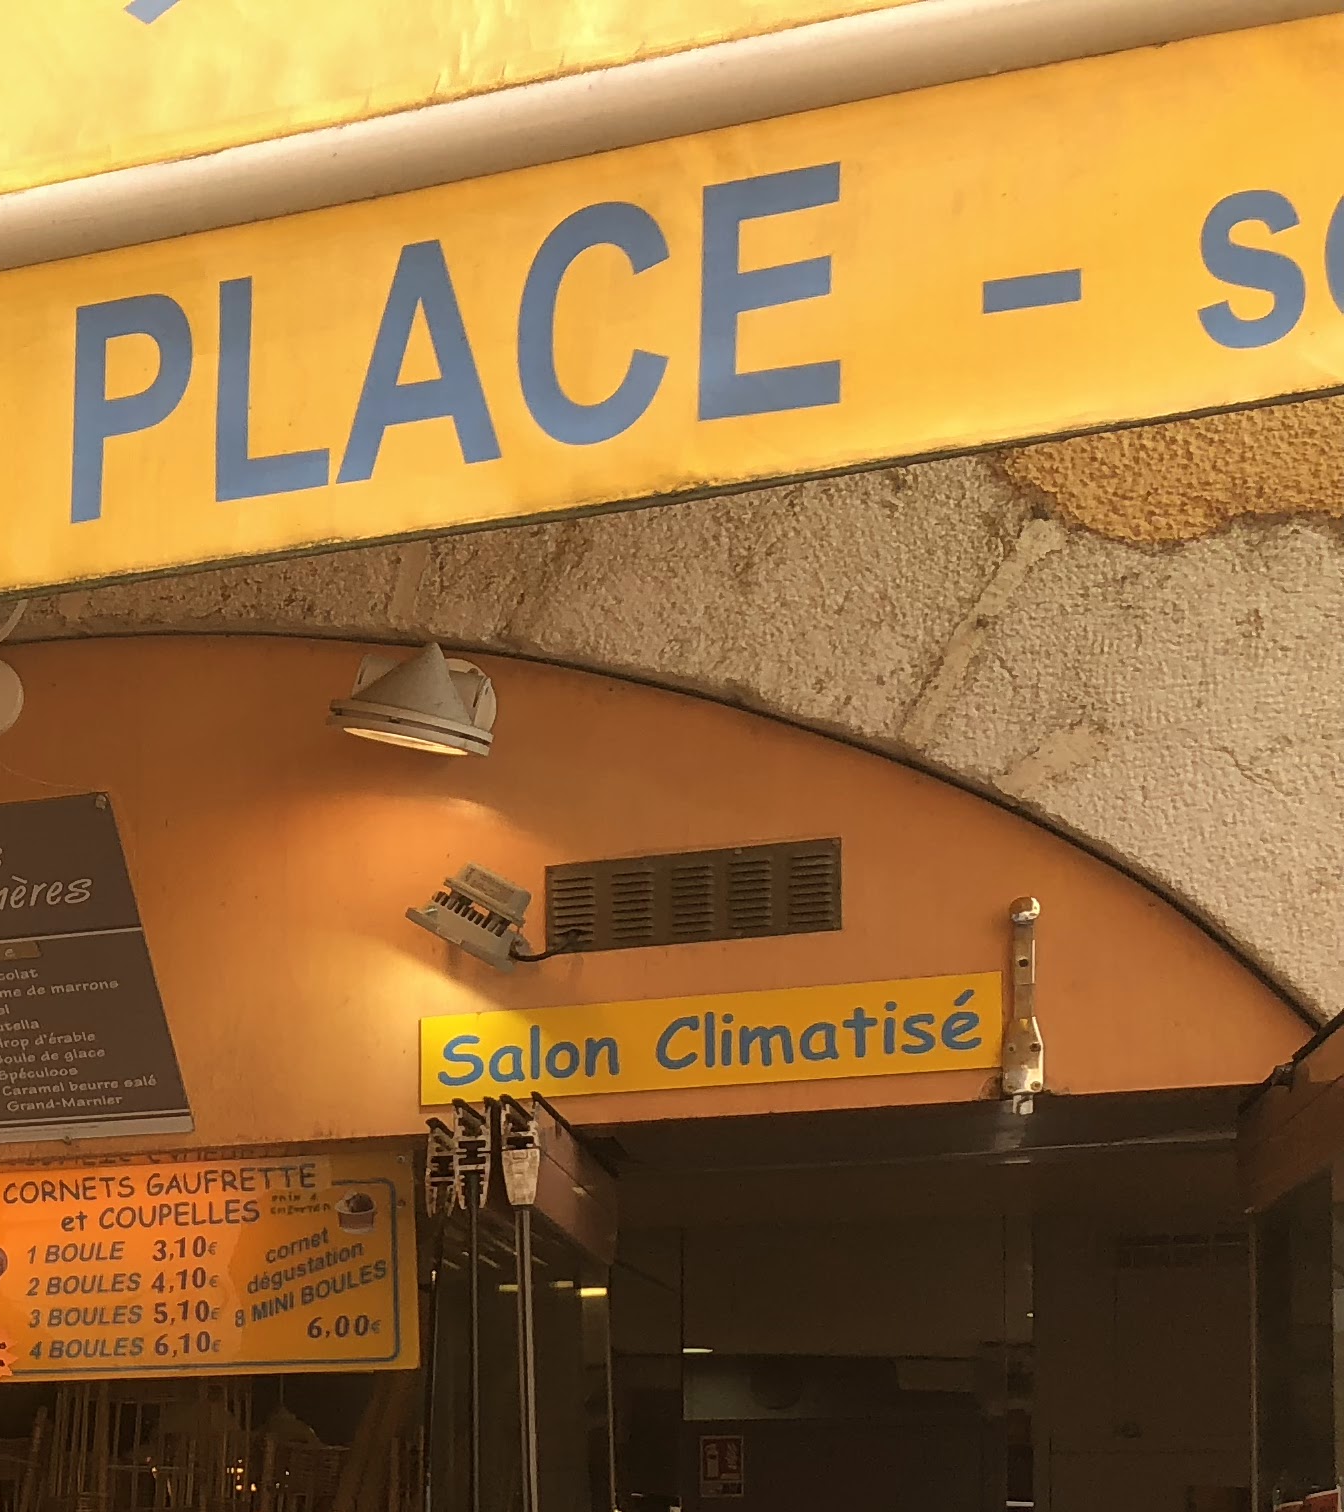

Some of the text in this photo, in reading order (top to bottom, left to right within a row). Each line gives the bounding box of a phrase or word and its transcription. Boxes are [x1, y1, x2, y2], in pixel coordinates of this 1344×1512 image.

[69, 160, 842, 526] PLACE
[1197, 189, 1344, 350] S
[27, 985, 45, 996] de
[51, 979, 119, 994] marrons
[437, 988, 983, 1087] Salon Climatisé
[41, 1050, 59, 1061] de
[64, 1048, 105, 1063] glace
[2, 1074, 157, 1097] Caramel beurre salé
[7, 1094, 123, 1112] Grand-Marnier
[2, 1163, 316, 1205] CORNETS GAUFRETTE
[61, 1199, 260, 1232] et COUPELLES
[27, 1245, 37, 1265] 1
[44, 1241, 126, 1264] BOULE
[265, 1227, 330, 1264] cornet
[247, 1242, 364, 1294] dégustation
[26, 1277, 40, 1296] 2
[45, 1272, 142, 1296] BOULES
[251, 1292, 294, 1322] MINI
[301, 1259, 387, 1306] BOULES
[28, 1309, 41, 1328] 3
[47, 1304, 143, 1327] BOULES
[29, 1340, 42, 1360] 4
[48, 1336, 145, 1359] BOULES
